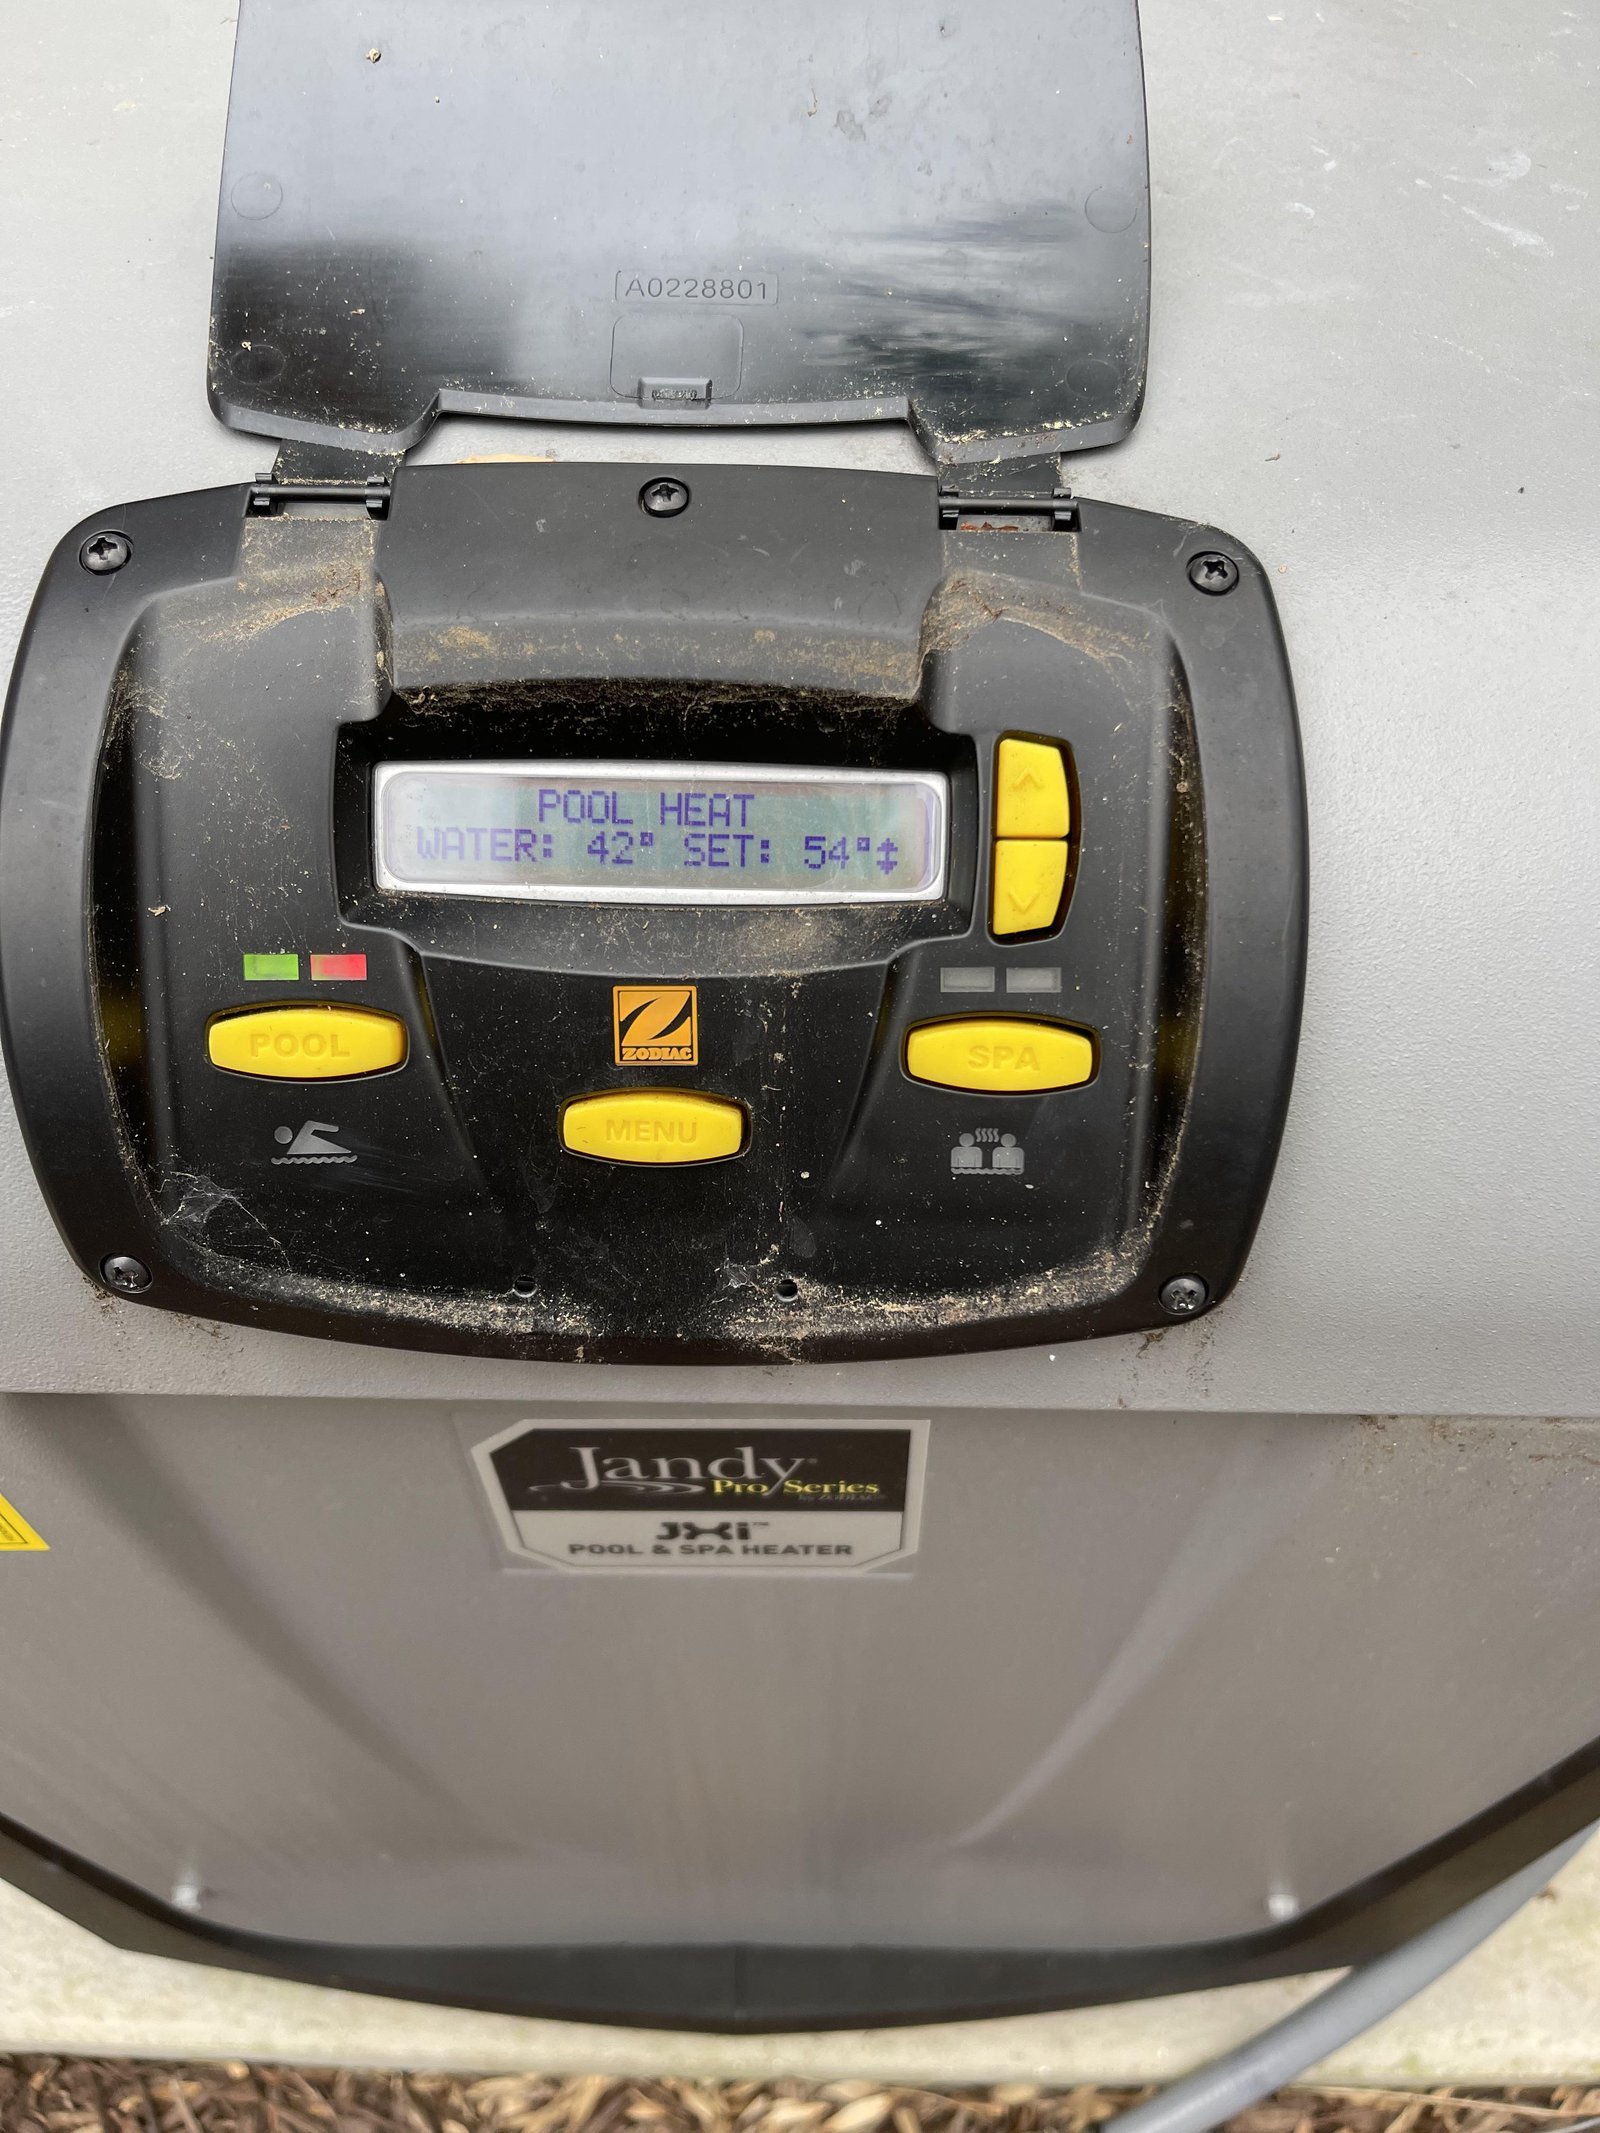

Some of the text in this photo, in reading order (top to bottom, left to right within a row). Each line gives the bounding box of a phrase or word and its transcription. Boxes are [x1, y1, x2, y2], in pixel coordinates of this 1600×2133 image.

[625, 277, 766, 300] A0228801
[538, 789, 755, 827] POOL HEAT
[416, 826, 552, 862] WATER:
[684, 833, 770, 868] SET:
[250, 1033, 351, 1058] POOL
[622, 1047, 692, 1060] ZODIAC
[967, 1045, 1041, 1071] SPA
[606, 1119, 698, 1144] MENU
[713, 1479, 880, 1494] Pro Series
[568, 1544, 853, 1556] POOL & SPA HEATER
